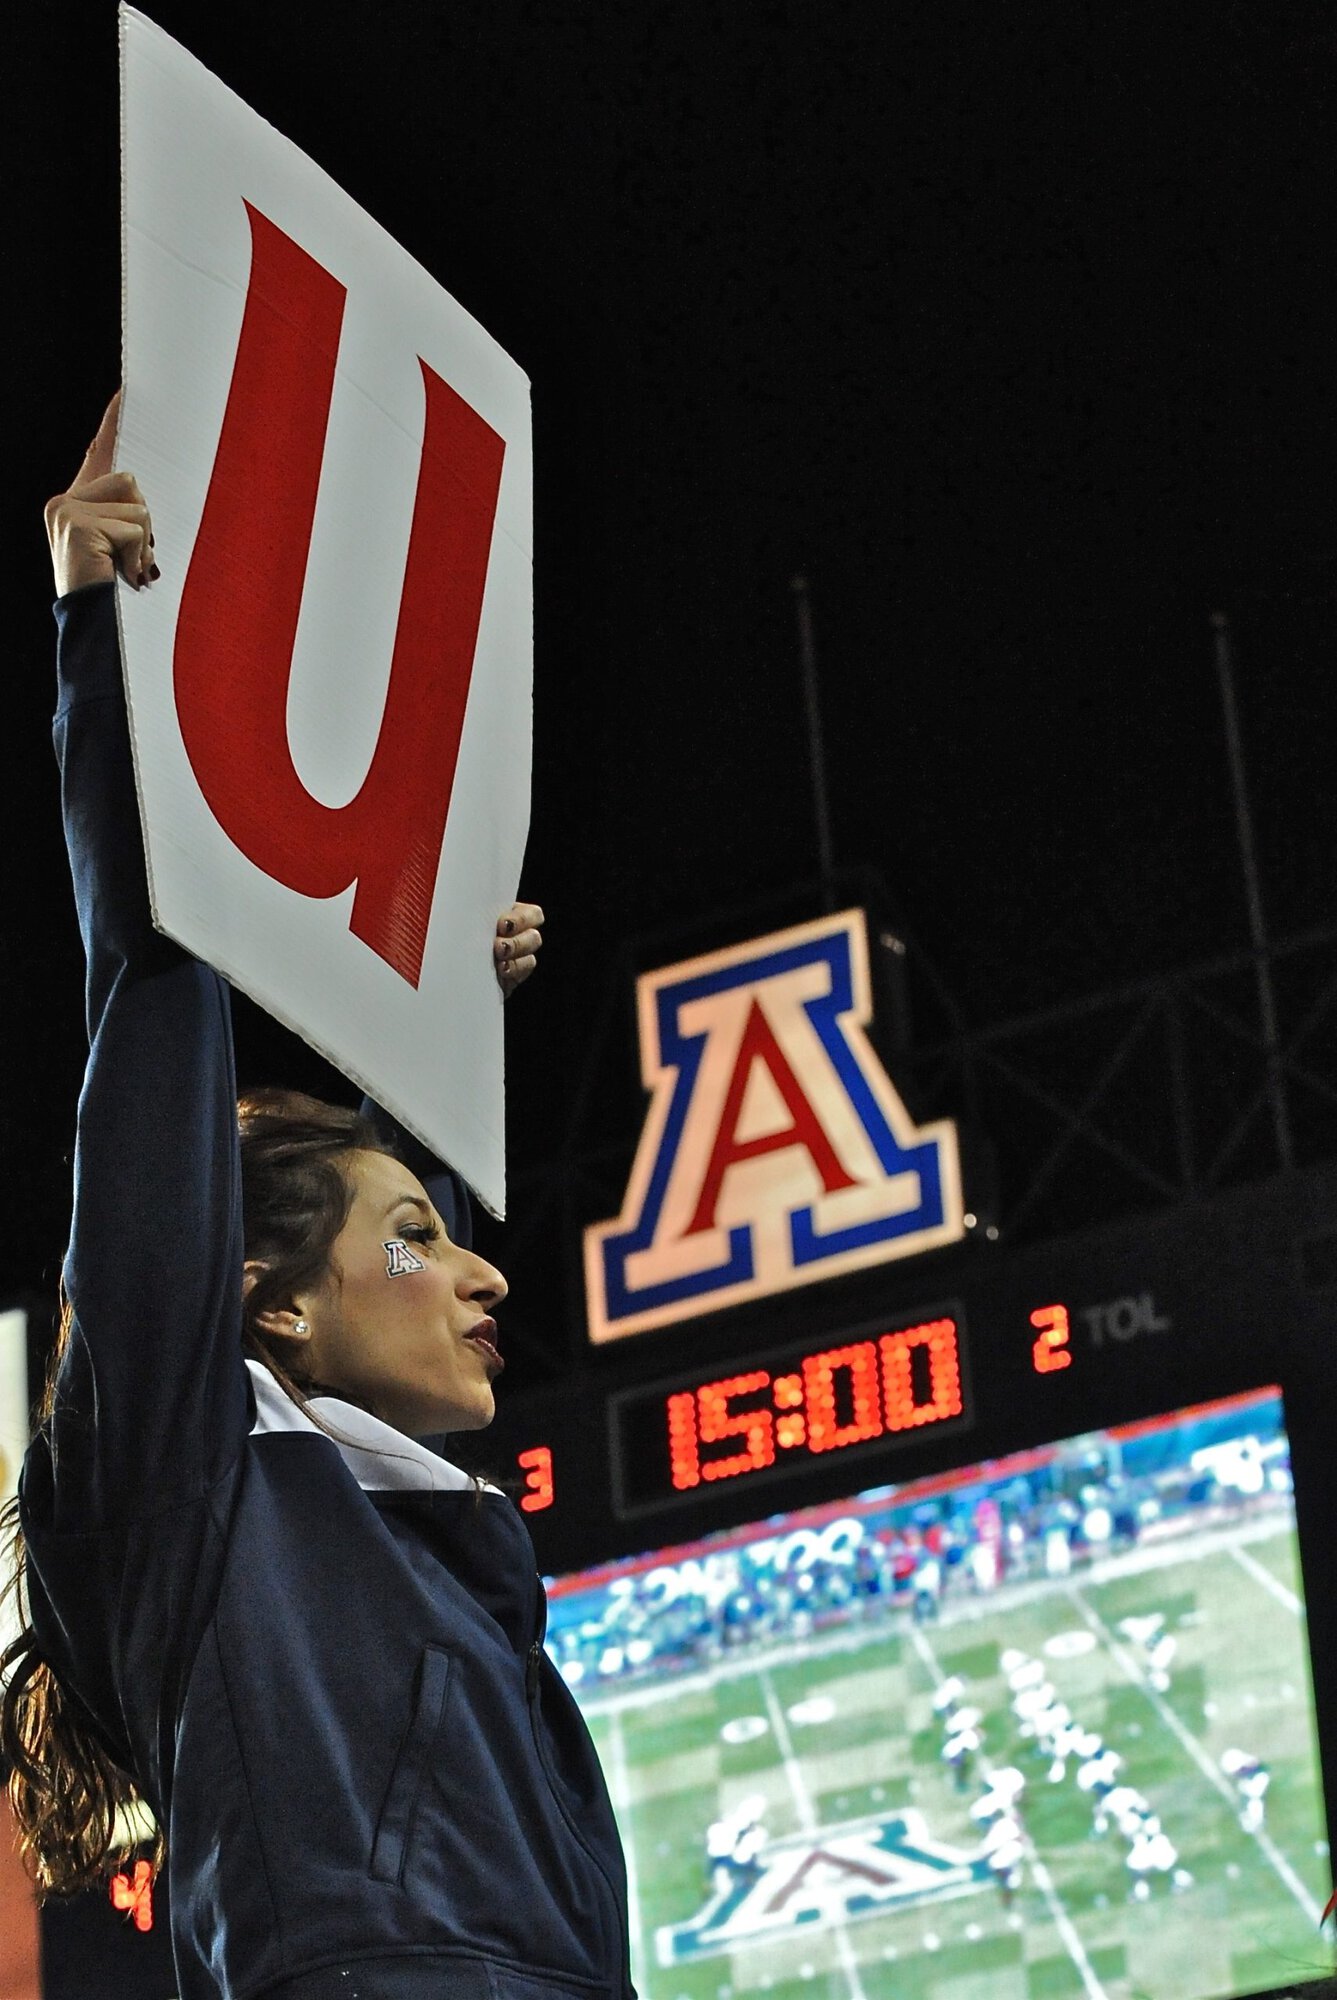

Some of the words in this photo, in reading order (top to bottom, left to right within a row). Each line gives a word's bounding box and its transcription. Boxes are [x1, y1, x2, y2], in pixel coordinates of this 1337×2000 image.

[584, 907, 964, 1345] A
[383, 1239, 426, 1279] A
[1030, 1305, 1071, 1373] 2
[1082, 1293, 1171, 1344] TOL
[668, 1319, 961, 1490] 15:00
[519, 1447, 553, 1512] 3
